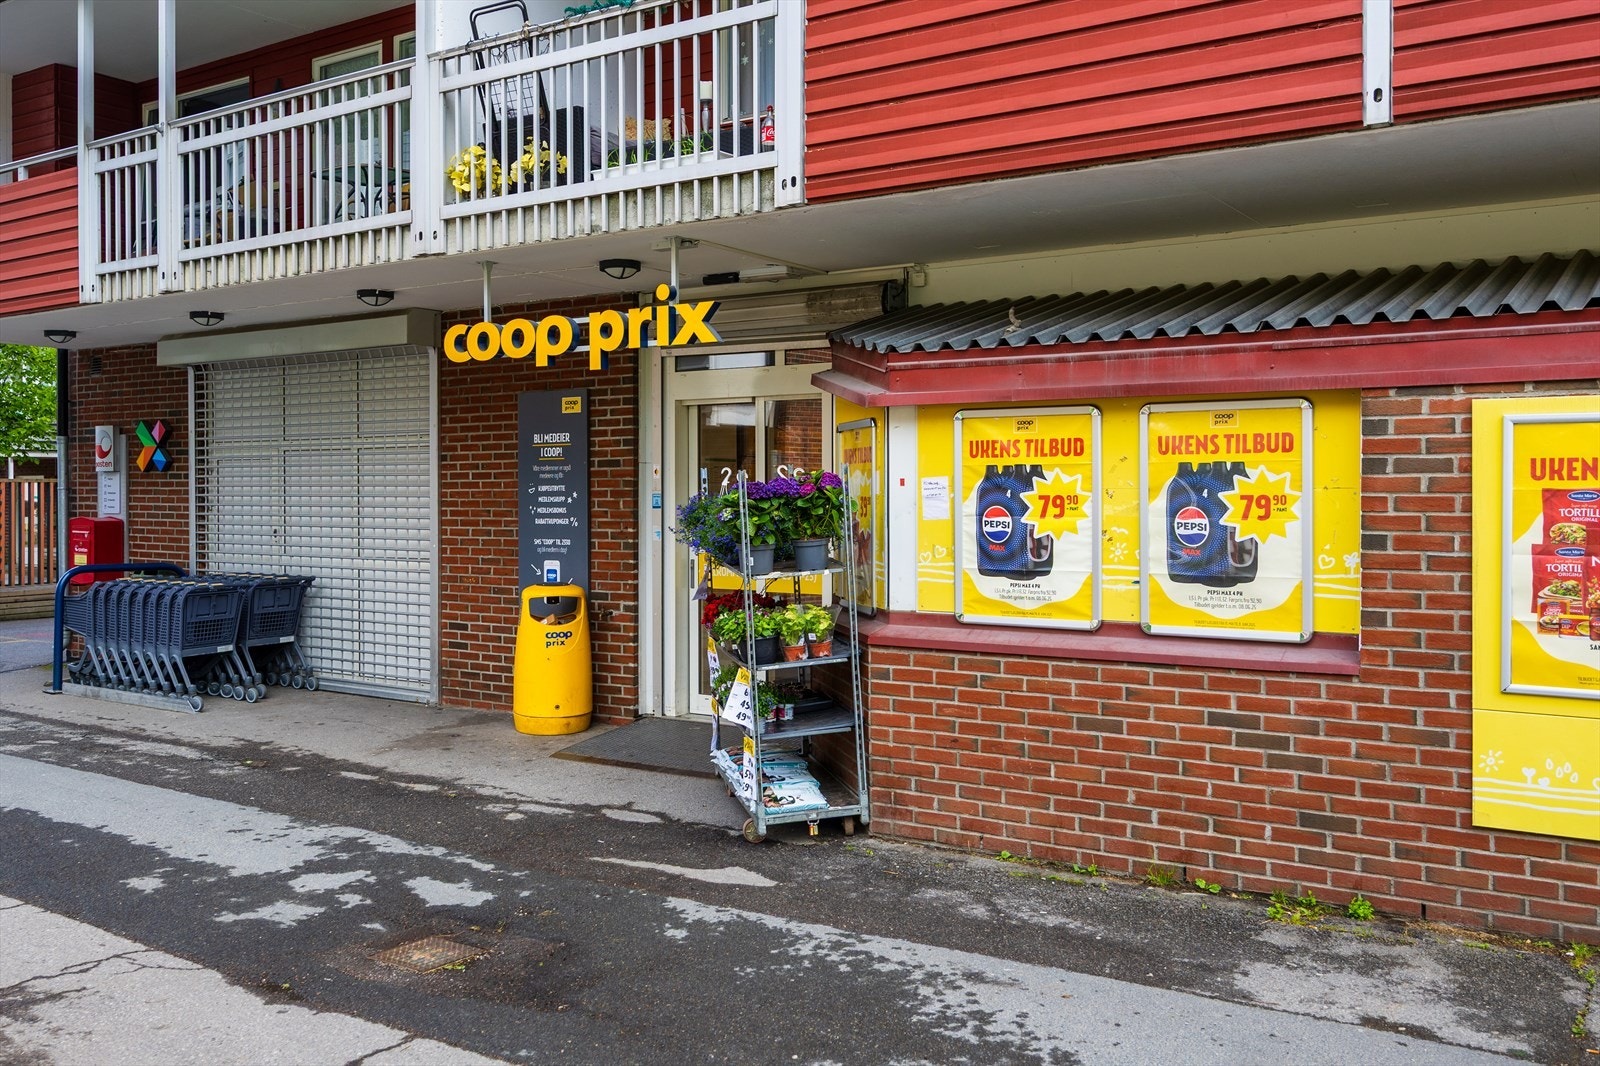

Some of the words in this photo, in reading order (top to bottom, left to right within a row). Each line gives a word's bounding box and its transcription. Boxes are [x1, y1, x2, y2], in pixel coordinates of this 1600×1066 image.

[444, 315, 577, 366] coop
[589, 284, 720, 370] prix
[534, 434, 543, 443] BLI
[544, 432, 570, 442] MEDEIER
[970, 439, 1020, 458] UKENS
[1024, 438, 1084, 458] TILBUD
[1158, 434, 1220, 455] UKENS
[1224, 432, 1294, 454] TILBUD
[544, 447, 562, 456] COOP!
[1006, 489, 1011, 498] 4
[1202, 489, 1208, 498] 4
[1038, 495, 1065, 519] 79
[1066, 495, 1078, 505] 90
[1240, 494, 1271, 521] 79
[1273, 495, 1286, 505] 90
[984, 520, 1010, 529] PEPSI
[1176, 522, 1207, 531] PEPSI
